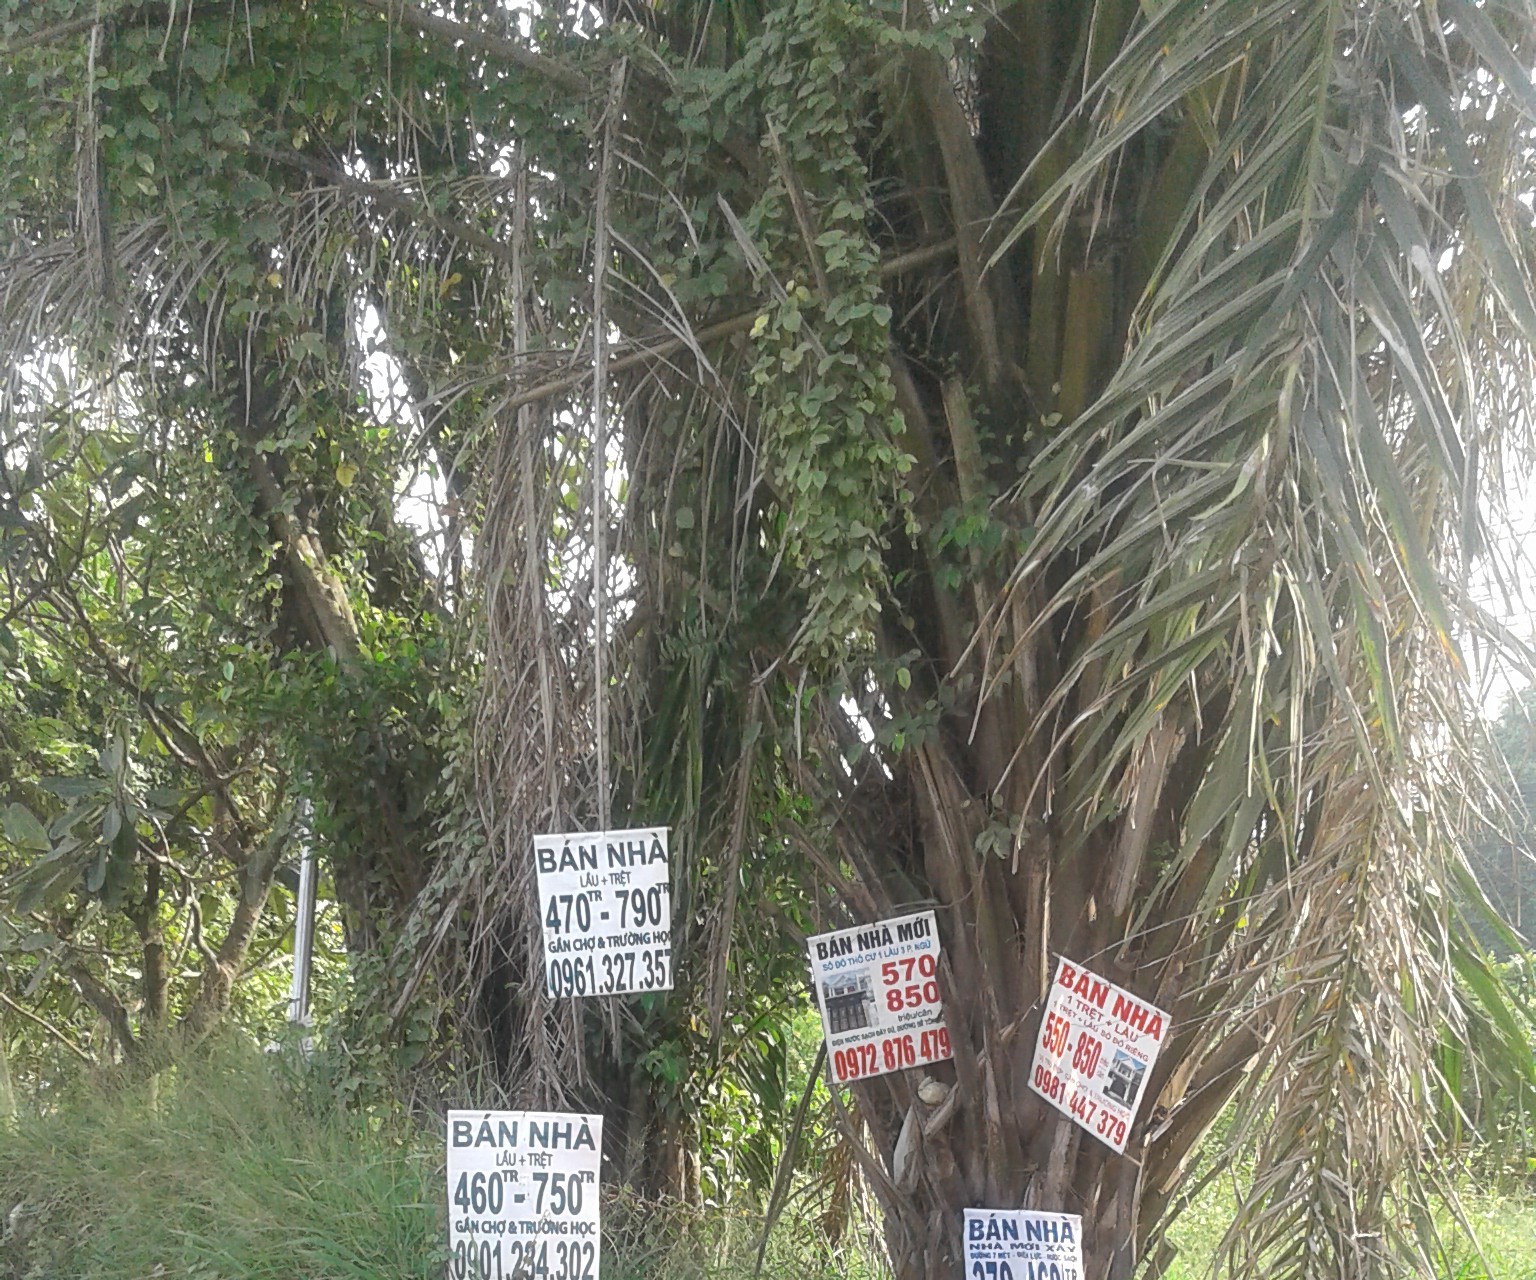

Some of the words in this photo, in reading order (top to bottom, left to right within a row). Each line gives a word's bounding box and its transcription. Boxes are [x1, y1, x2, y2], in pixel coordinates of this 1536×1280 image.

[537, 840, 598, 873] BÁN
[607, 833, 668, 868] NHÀ
[573, 936, 595, 953] CHỢ
[607, 932, 650, 947] TRƯỜNG
[816, 932, 853, 960] BÁN
[857, 926, 893, 952] NHÀ
[897, 917, 930, 942] MỚI
[882, 954, 935, 985] 570
[886, 981, 940, 1013] 850
[1058, 964, 1109, 1009] BÁN
[1112, 993, 1163, 1041] NHÀ
[834, 1043, 879, 1081] 0972
[882, 1035, 915, 1071] 876
[920, 1027, 951, 1062] 479
[1043, 1011, 1070, 1058] 550
[1072, 1031, 1103, 1079] 850
[1035, 1065, 1066, 1105] 0981
[1070, 1091, 1097, 1124] 447
[1097, 1109, 1126, 1146] 379
[453, 1114, 518, 1148] BÁN
[529, 1117, 596, 1150] NHÀ
[481, 1220, 507, 1237] CHỢ
[571, 1222, 596, 1238] HỌC
[969, 1214, 1019, 1241] BÁN
[1025, 1216, 1075, 1244] NHÀ
